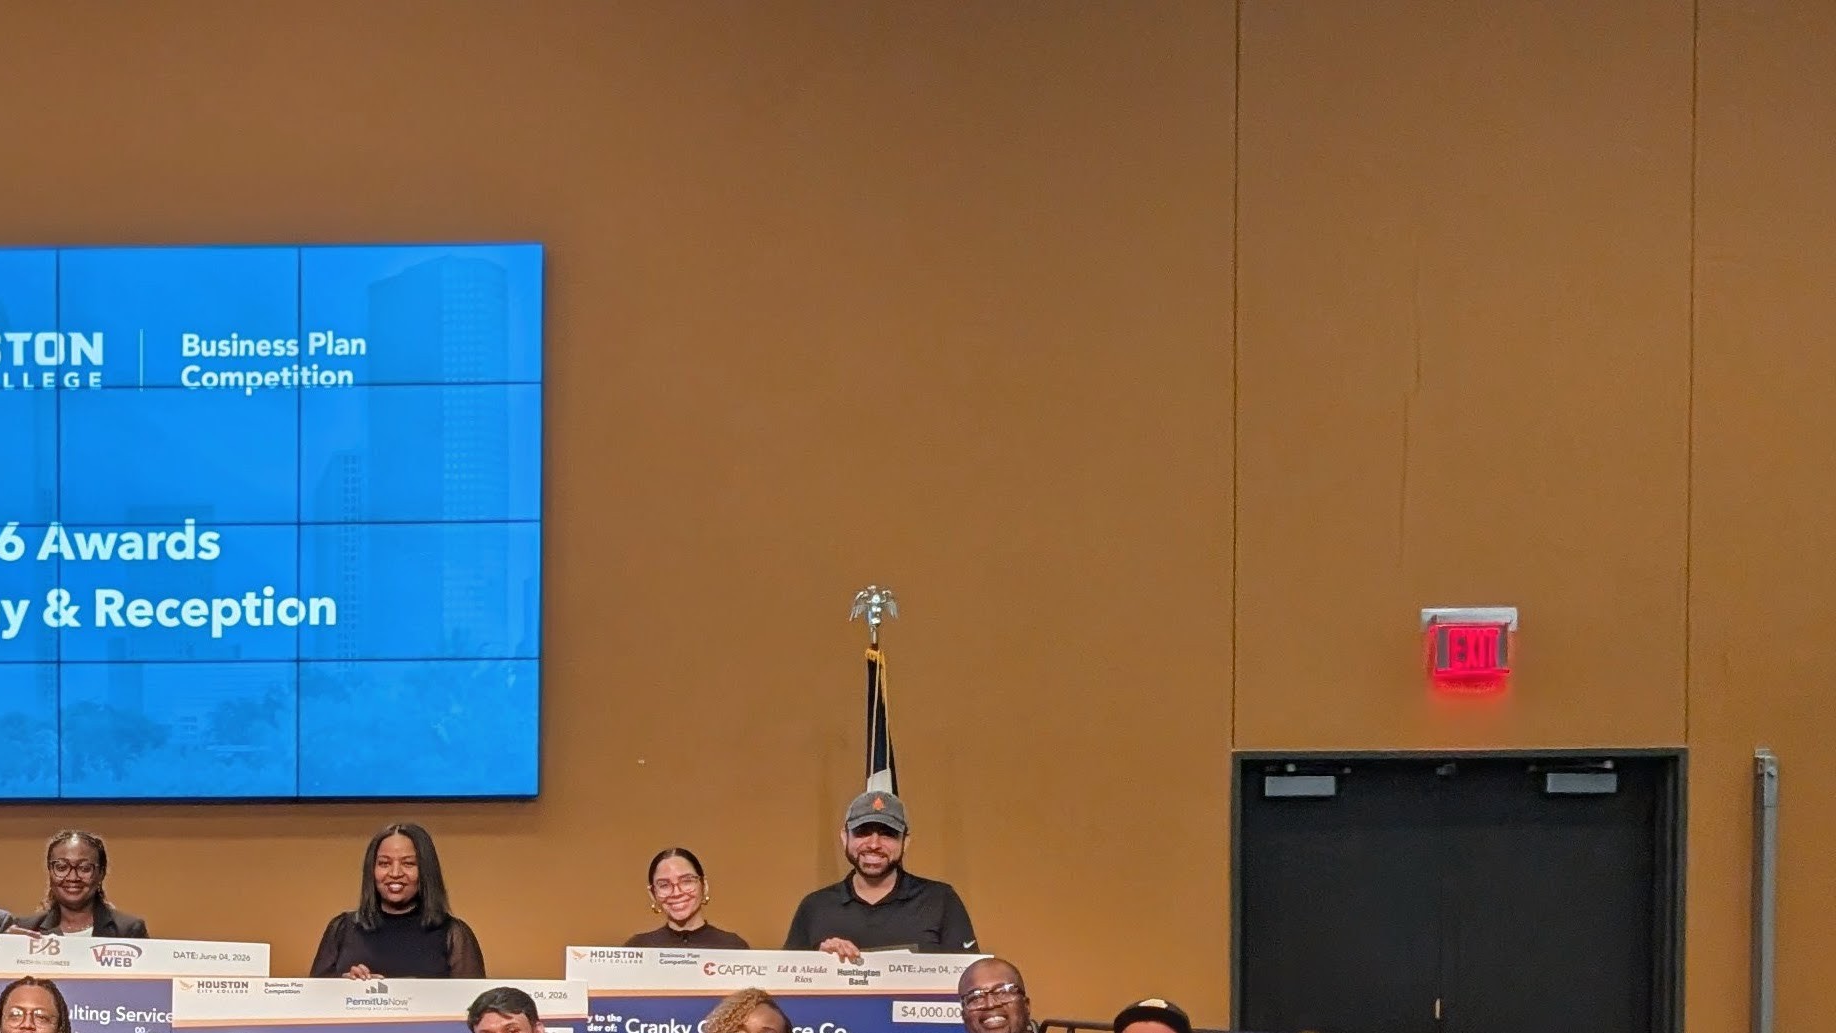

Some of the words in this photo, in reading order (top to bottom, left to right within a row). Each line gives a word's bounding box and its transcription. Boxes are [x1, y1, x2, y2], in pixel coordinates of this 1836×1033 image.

[181, 333, 300, 360] Business
[308, 333, 367, 360] Plan
[180, 364, 355, 396] Competition
[37, 521, 220, 563] Awards
[44, 591, 83, 628] &
[95, 588, 337, 638] Reception
[590, 950, 643, 959] HOUSTON
[100, 958, 132, 967] WEB
[777, 965, 788, 973] Ed
[837, 969, 881, 977] Huntington
[888, 964, 916, 973] DATE:
[918, 965, 936, 974] June
[939, 965, 951, 974] 04,
[197, 981, 249, 989] HOUSTON
[849, 978, 868, 986] Bank
[902, 1006, 961, 1018] $4,000.00
